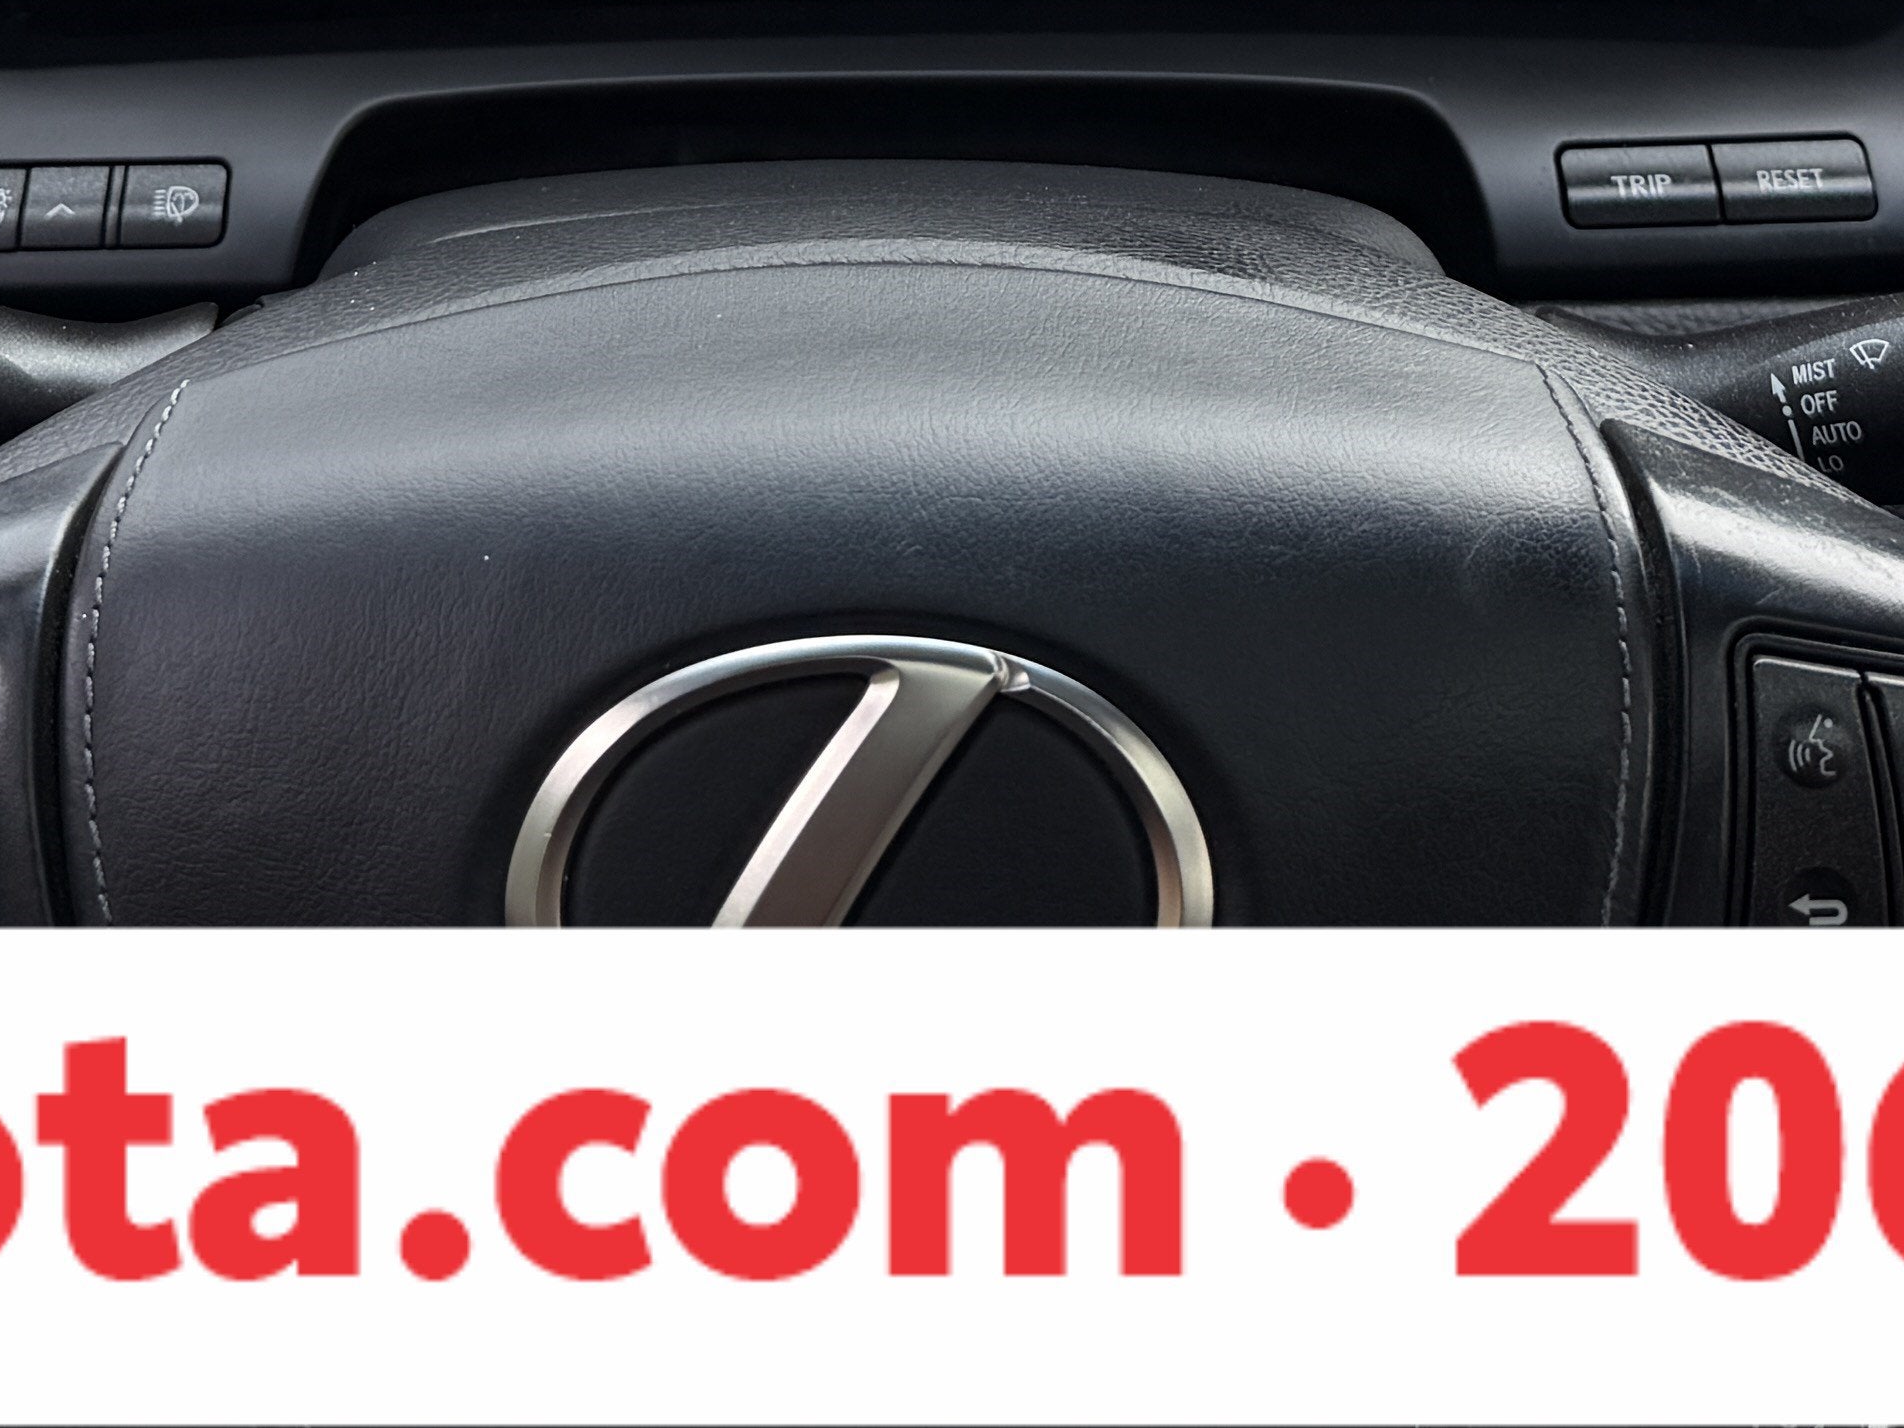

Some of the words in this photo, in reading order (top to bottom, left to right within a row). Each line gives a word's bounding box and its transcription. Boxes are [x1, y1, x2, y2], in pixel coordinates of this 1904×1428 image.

[1611, 173, 1672, 199] TRIP
[1756, 168, 1824, 193] RESET
[1791, 358, 1836, 386] MIST
[1801, 389, 1839, 417] OFF
[1812, 421, 1863, 446] AUTO
[1819, 454, 1845, 473] LO
